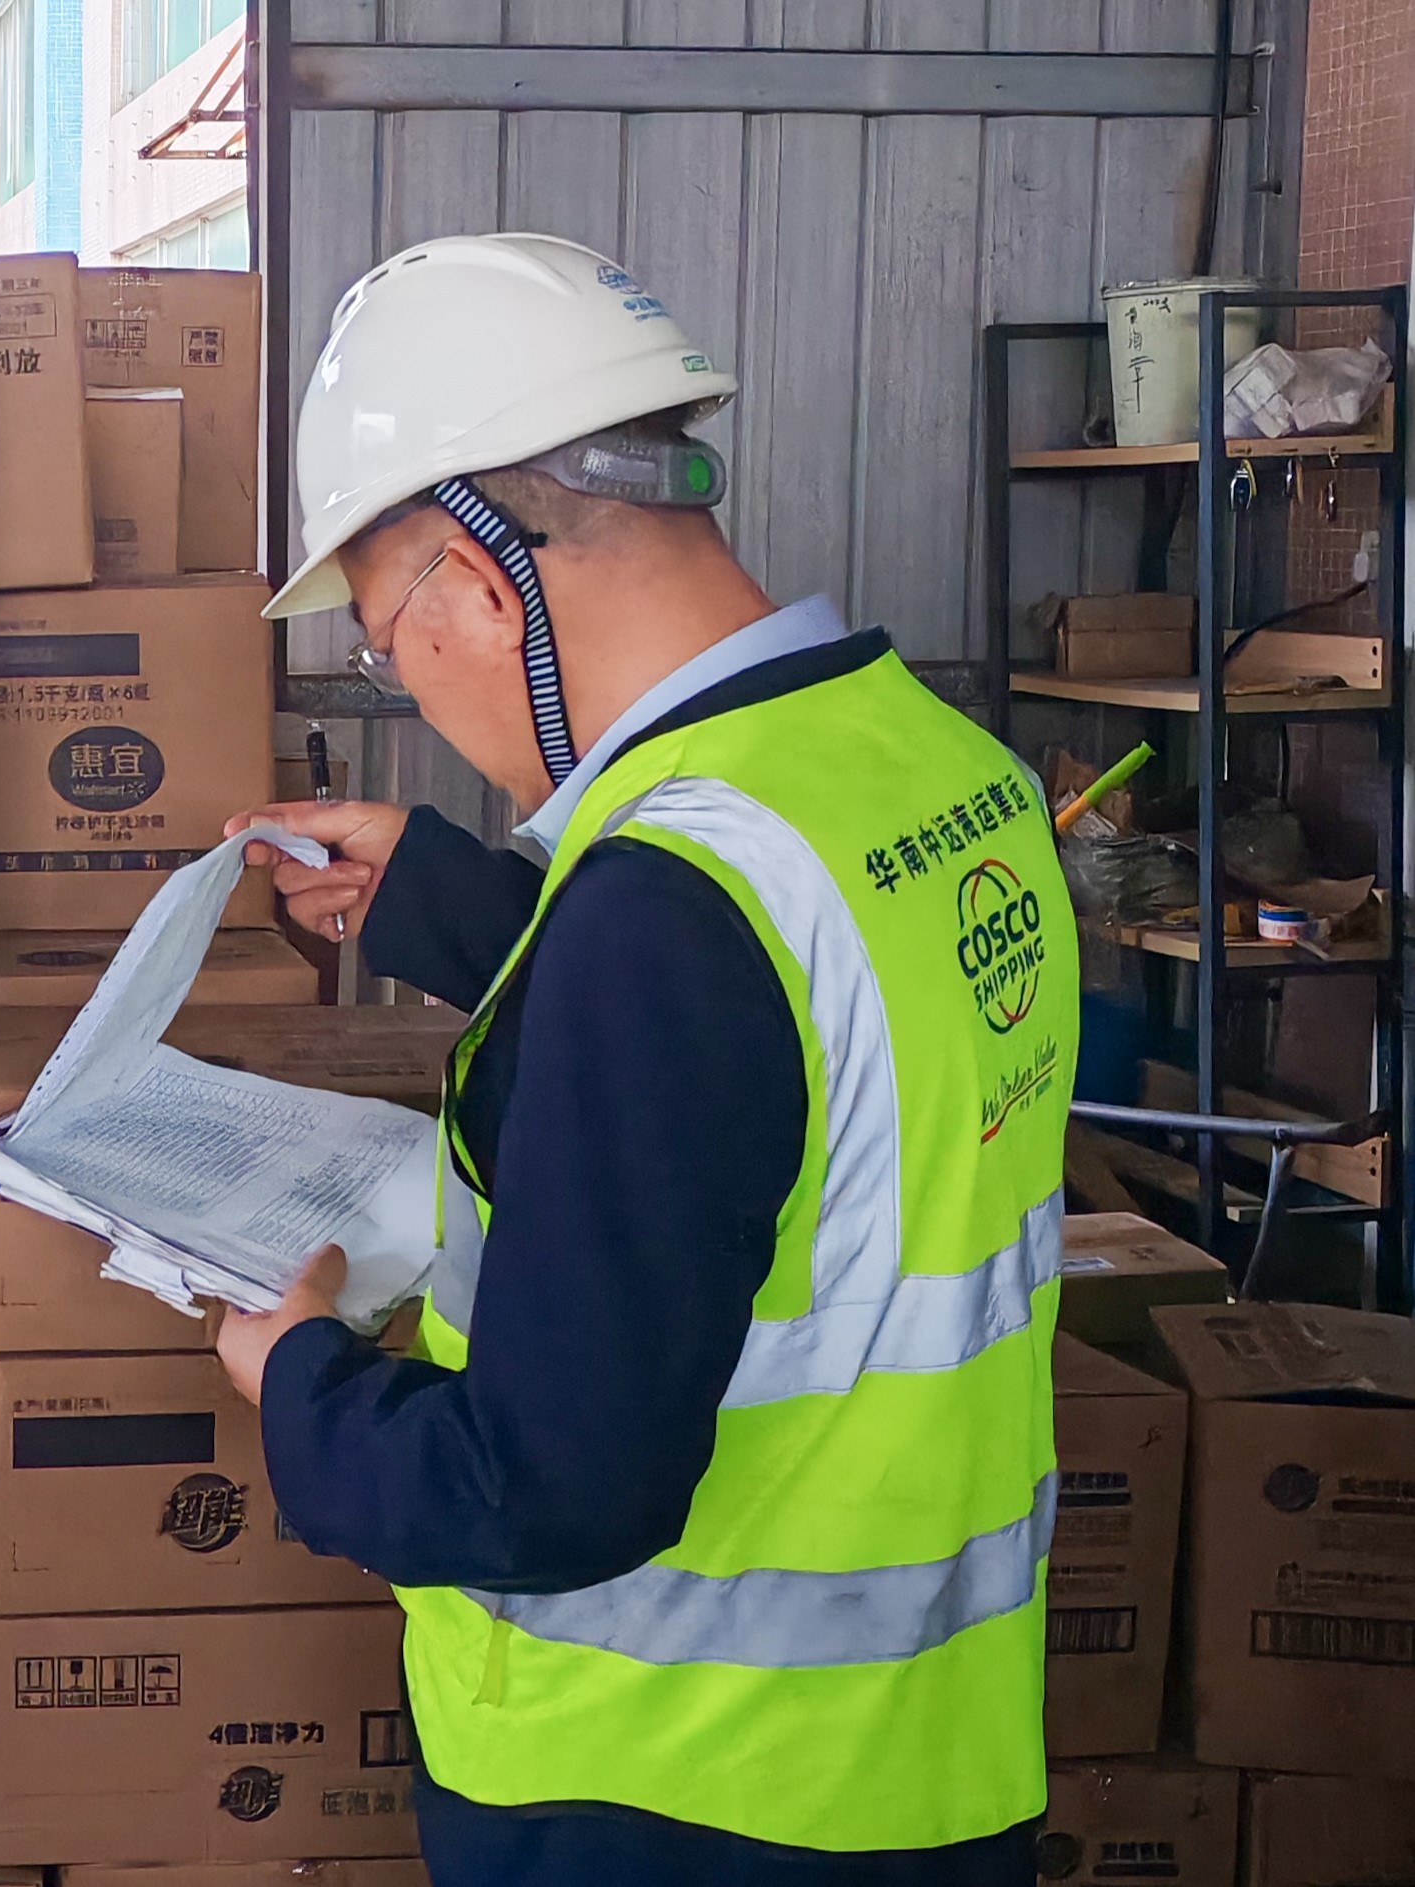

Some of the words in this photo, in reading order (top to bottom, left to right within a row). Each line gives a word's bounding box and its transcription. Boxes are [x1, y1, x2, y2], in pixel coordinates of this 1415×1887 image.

[70, 743, 146, 779] 惠宜
[956, 889, 1041, 981] COSCO
[974, 935, 1045, 1014] SHIPPING
